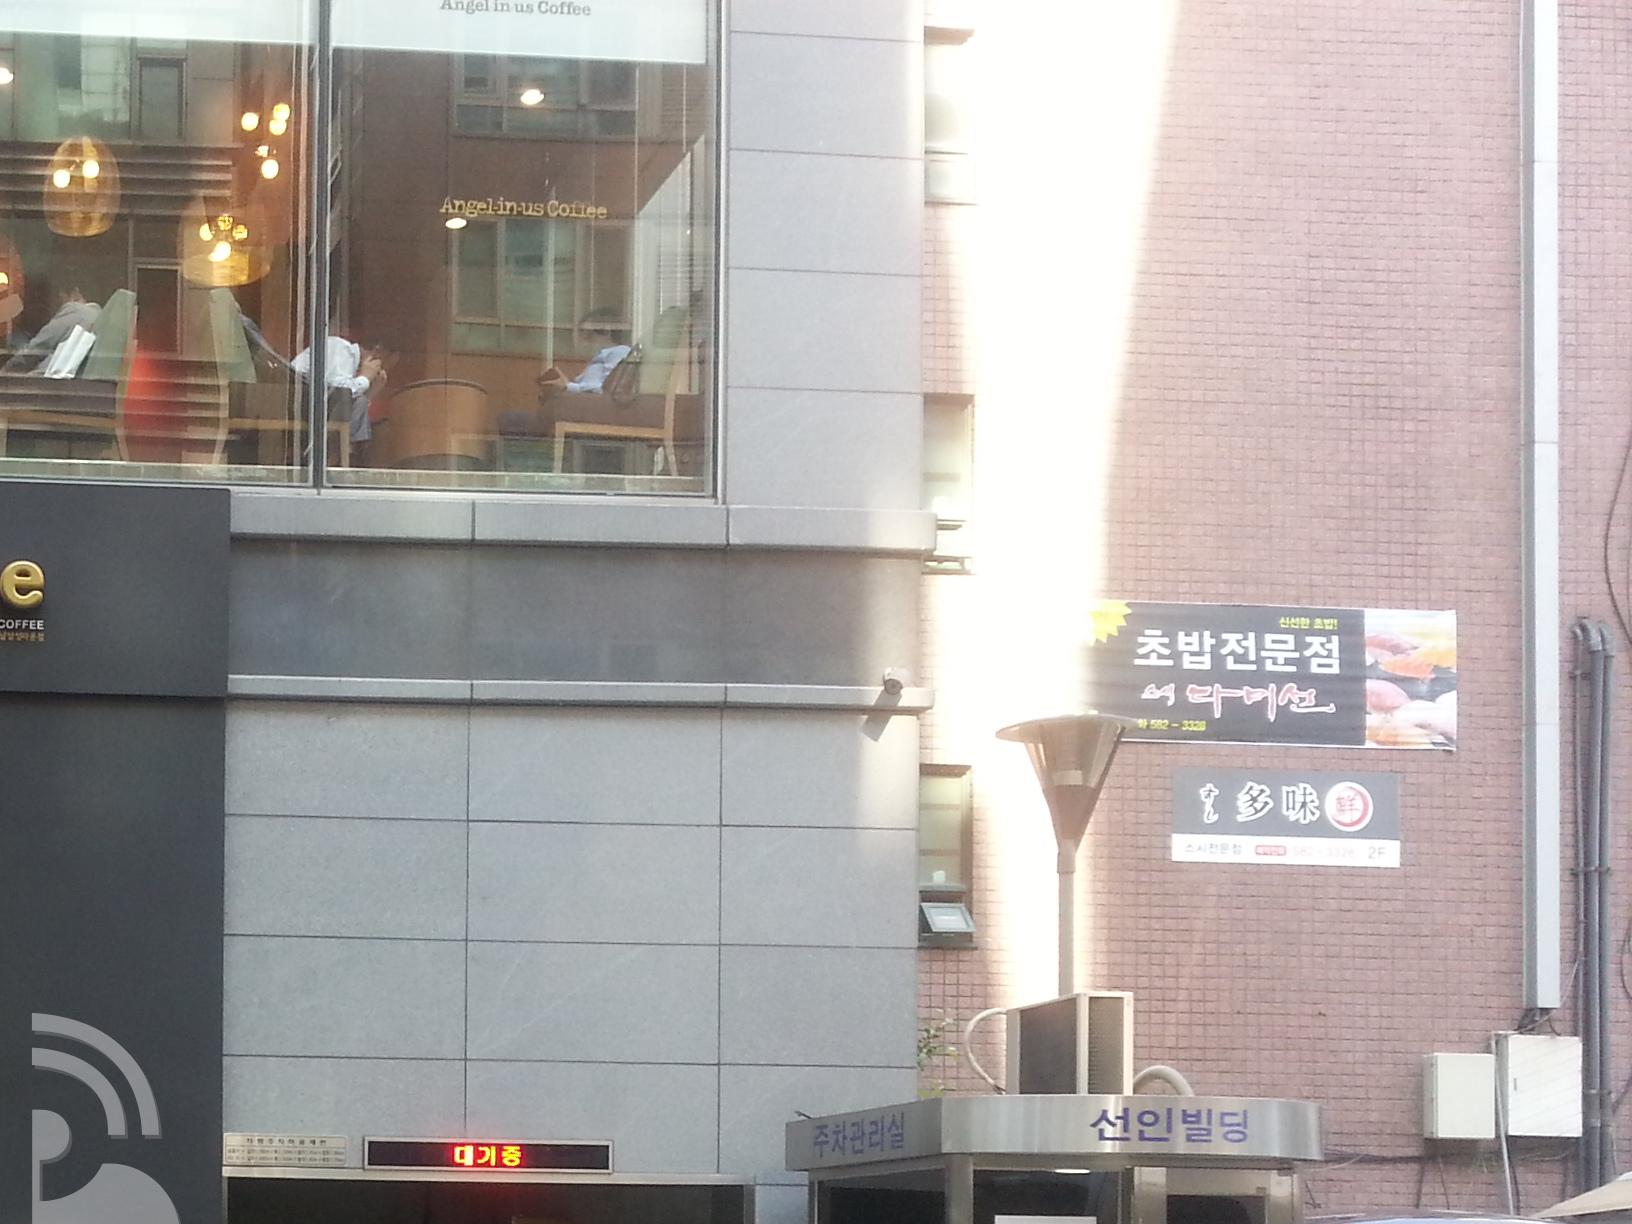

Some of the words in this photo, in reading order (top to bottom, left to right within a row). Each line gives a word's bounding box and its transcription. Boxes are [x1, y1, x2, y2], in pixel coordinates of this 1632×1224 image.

[547, 200, 608, 219] Coffee
[1134, 629, 1341, 675] 초밥전문점
[1368, 846, 1386, 860] 2F
[812, 1110, 907, 1158] 주차관리실
[1089, 1106, 1250, 1144] 선인빌딩
[453, 1144, 522, 1167] 대기중
